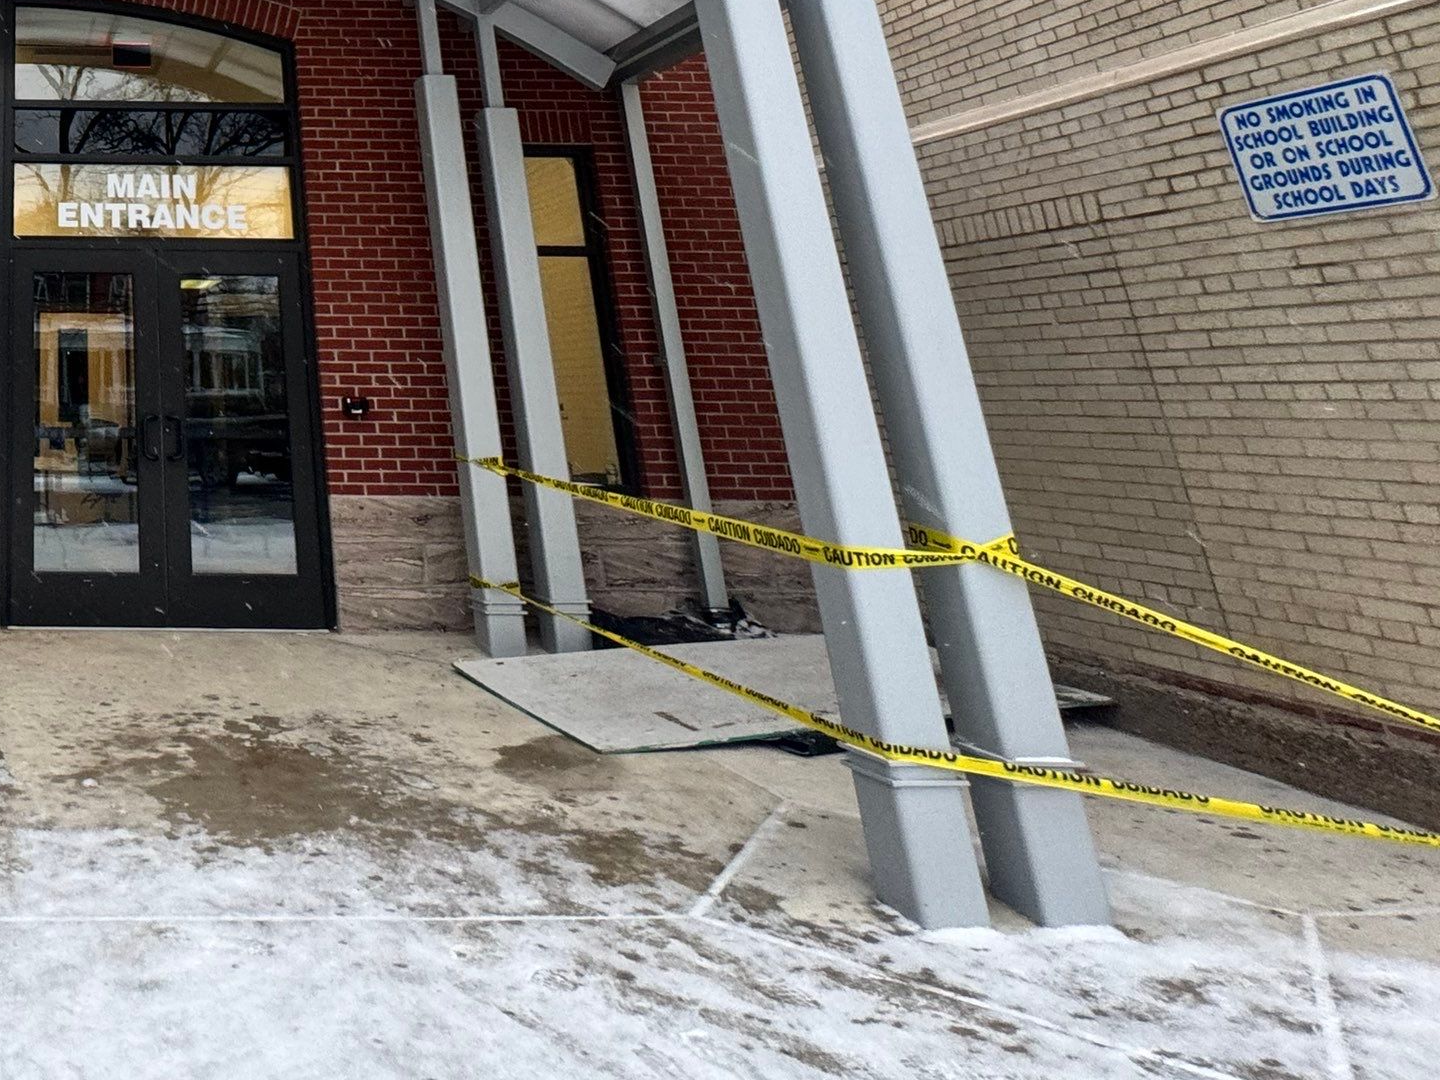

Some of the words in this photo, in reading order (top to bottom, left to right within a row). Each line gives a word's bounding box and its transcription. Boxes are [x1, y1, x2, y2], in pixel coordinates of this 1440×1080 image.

[1233, 111, 1261, 130] NO
[1266, 91, 1350, 124] SMOKING
[1354, 85, 1378, 105] IN
[1234, 124, 1304, 152] SCHOOL
[1307, 105, 1395, 138] BUILDING
[1249, 151, 1277, 170] OR
[1281, 144, 1311, 164] ON
[1315, 129, 1394, 159] SCHOOL
[1249, 163, 1332, 191] GROUNDS
[1336, 149, 1412, 178] DURING
[105, 172, 197, 200] MAIN
[1272, 183, 1347, 210] SCHOOL
[1350, 175, 1401, 198] DAYS
[56, 200, 249, 231] ENTRANCE
[656, 504, 692, 526] CUIDADO
[707, 517, 751, 543] CAUTION
[753, 528, 802, 555] CUIDADO
[822, 546, 895, 567] CAUTION
